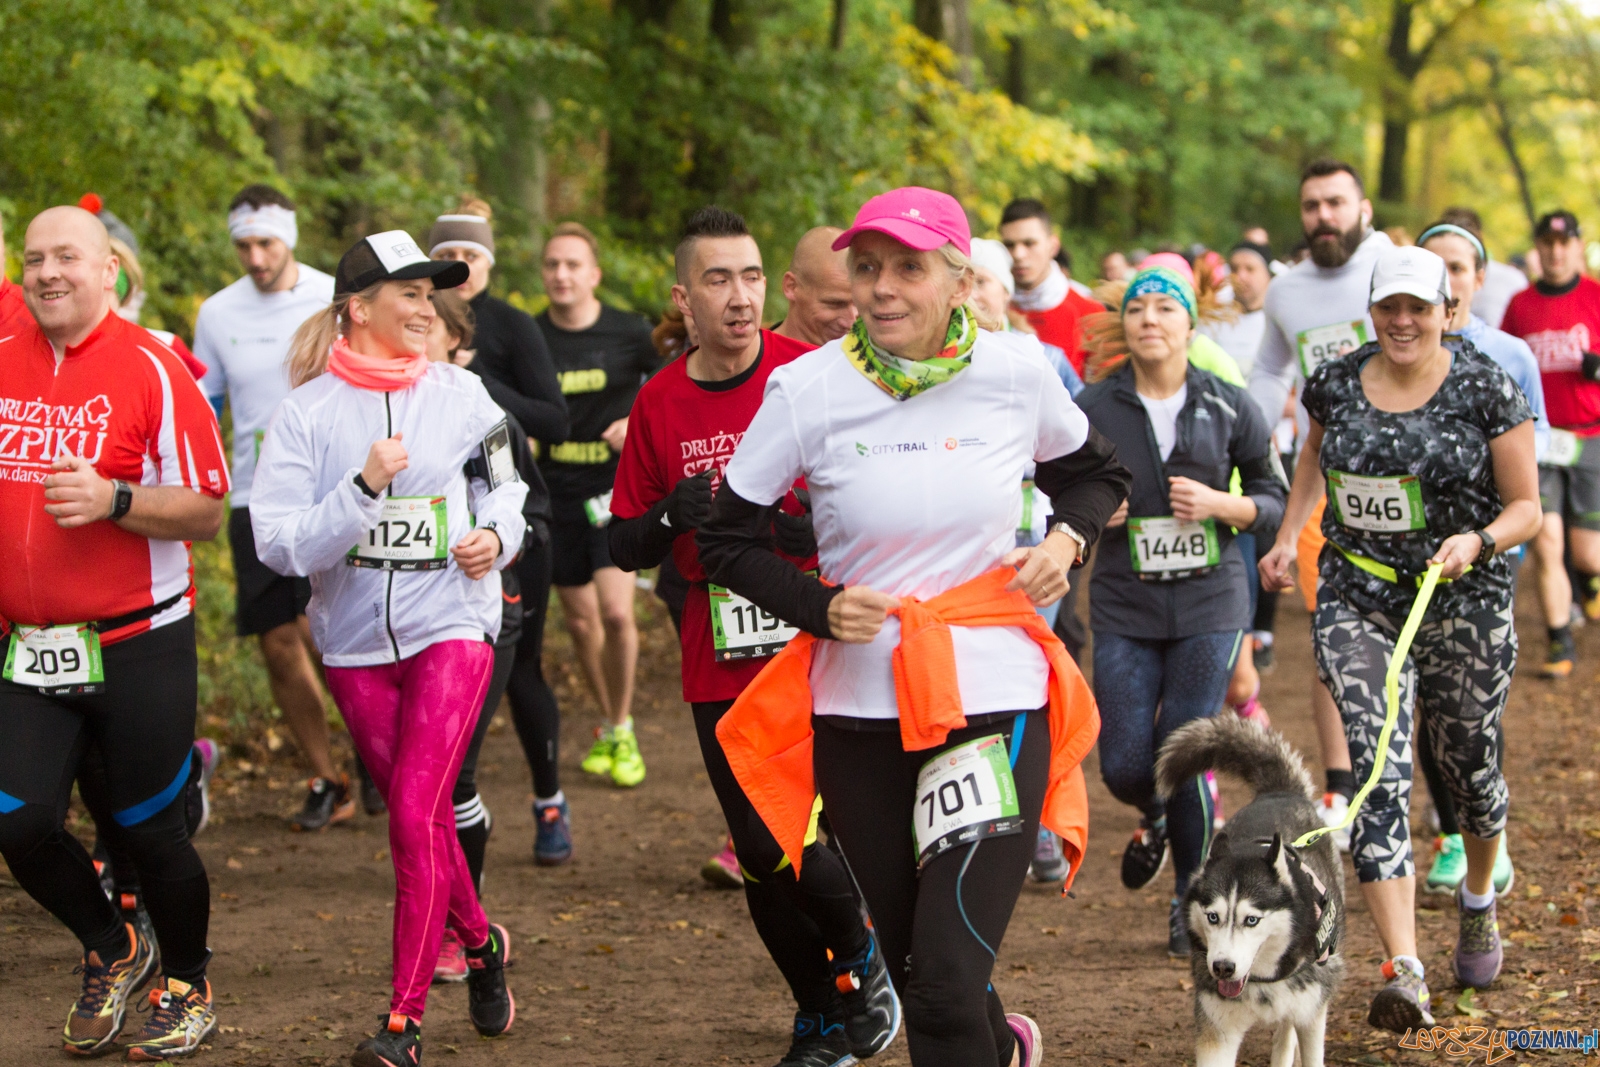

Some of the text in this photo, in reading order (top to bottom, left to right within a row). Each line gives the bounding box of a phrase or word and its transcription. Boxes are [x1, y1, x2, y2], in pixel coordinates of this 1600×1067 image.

[680, 431, 747, 463] DRUŻY
[1346, 493, 1403, 521] 946
[369, 519, 432, 547] 1124
[1140, 533, 1206, 561] 1448
[731, 603, 793, 635] 119
[25, 647, 80, 675] 209
[920, 772, 983, 829] 701
[998, 772, 1014, 806] Poznań
[942, 816, 963, 832] EWA
